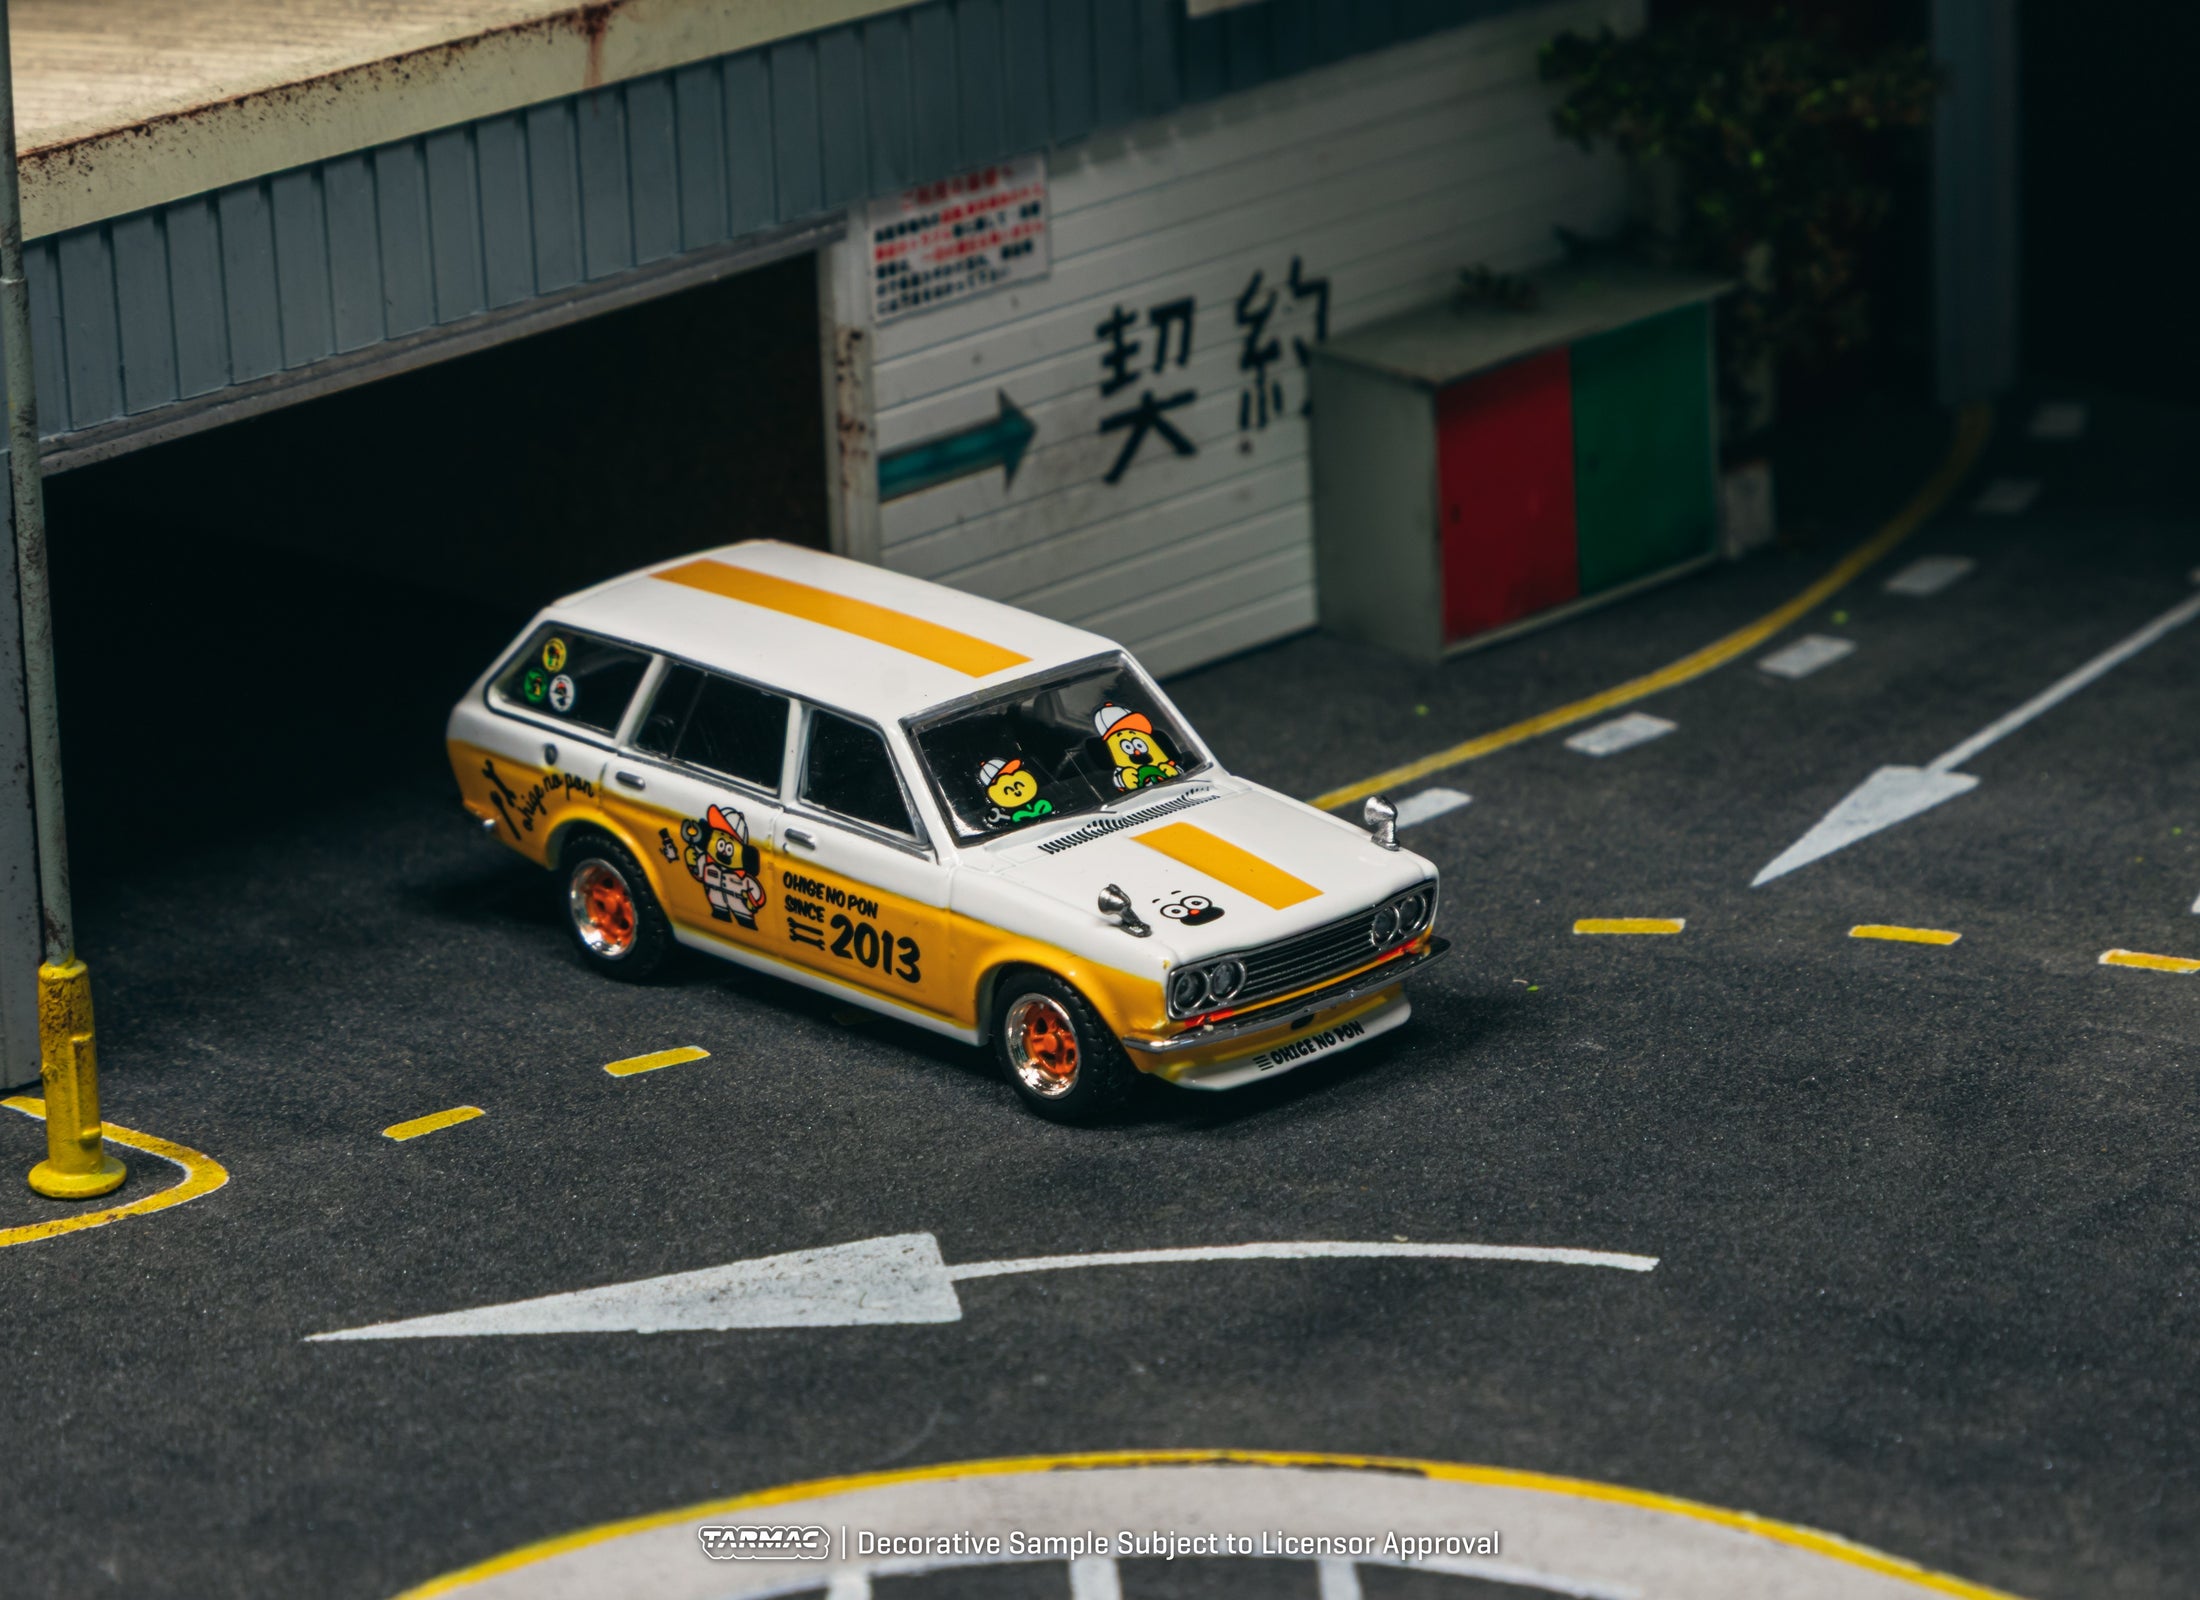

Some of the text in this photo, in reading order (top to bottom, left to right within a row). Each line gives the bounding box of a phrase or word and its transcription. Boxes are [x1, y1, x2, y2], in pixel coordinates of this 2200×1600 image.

[783, 871, 878, 919] OHIGE NO PON
[785, 894, 921, 983] SINCE 2013
[1270, 1020, 1365, 1065] OHIGE NO PON
